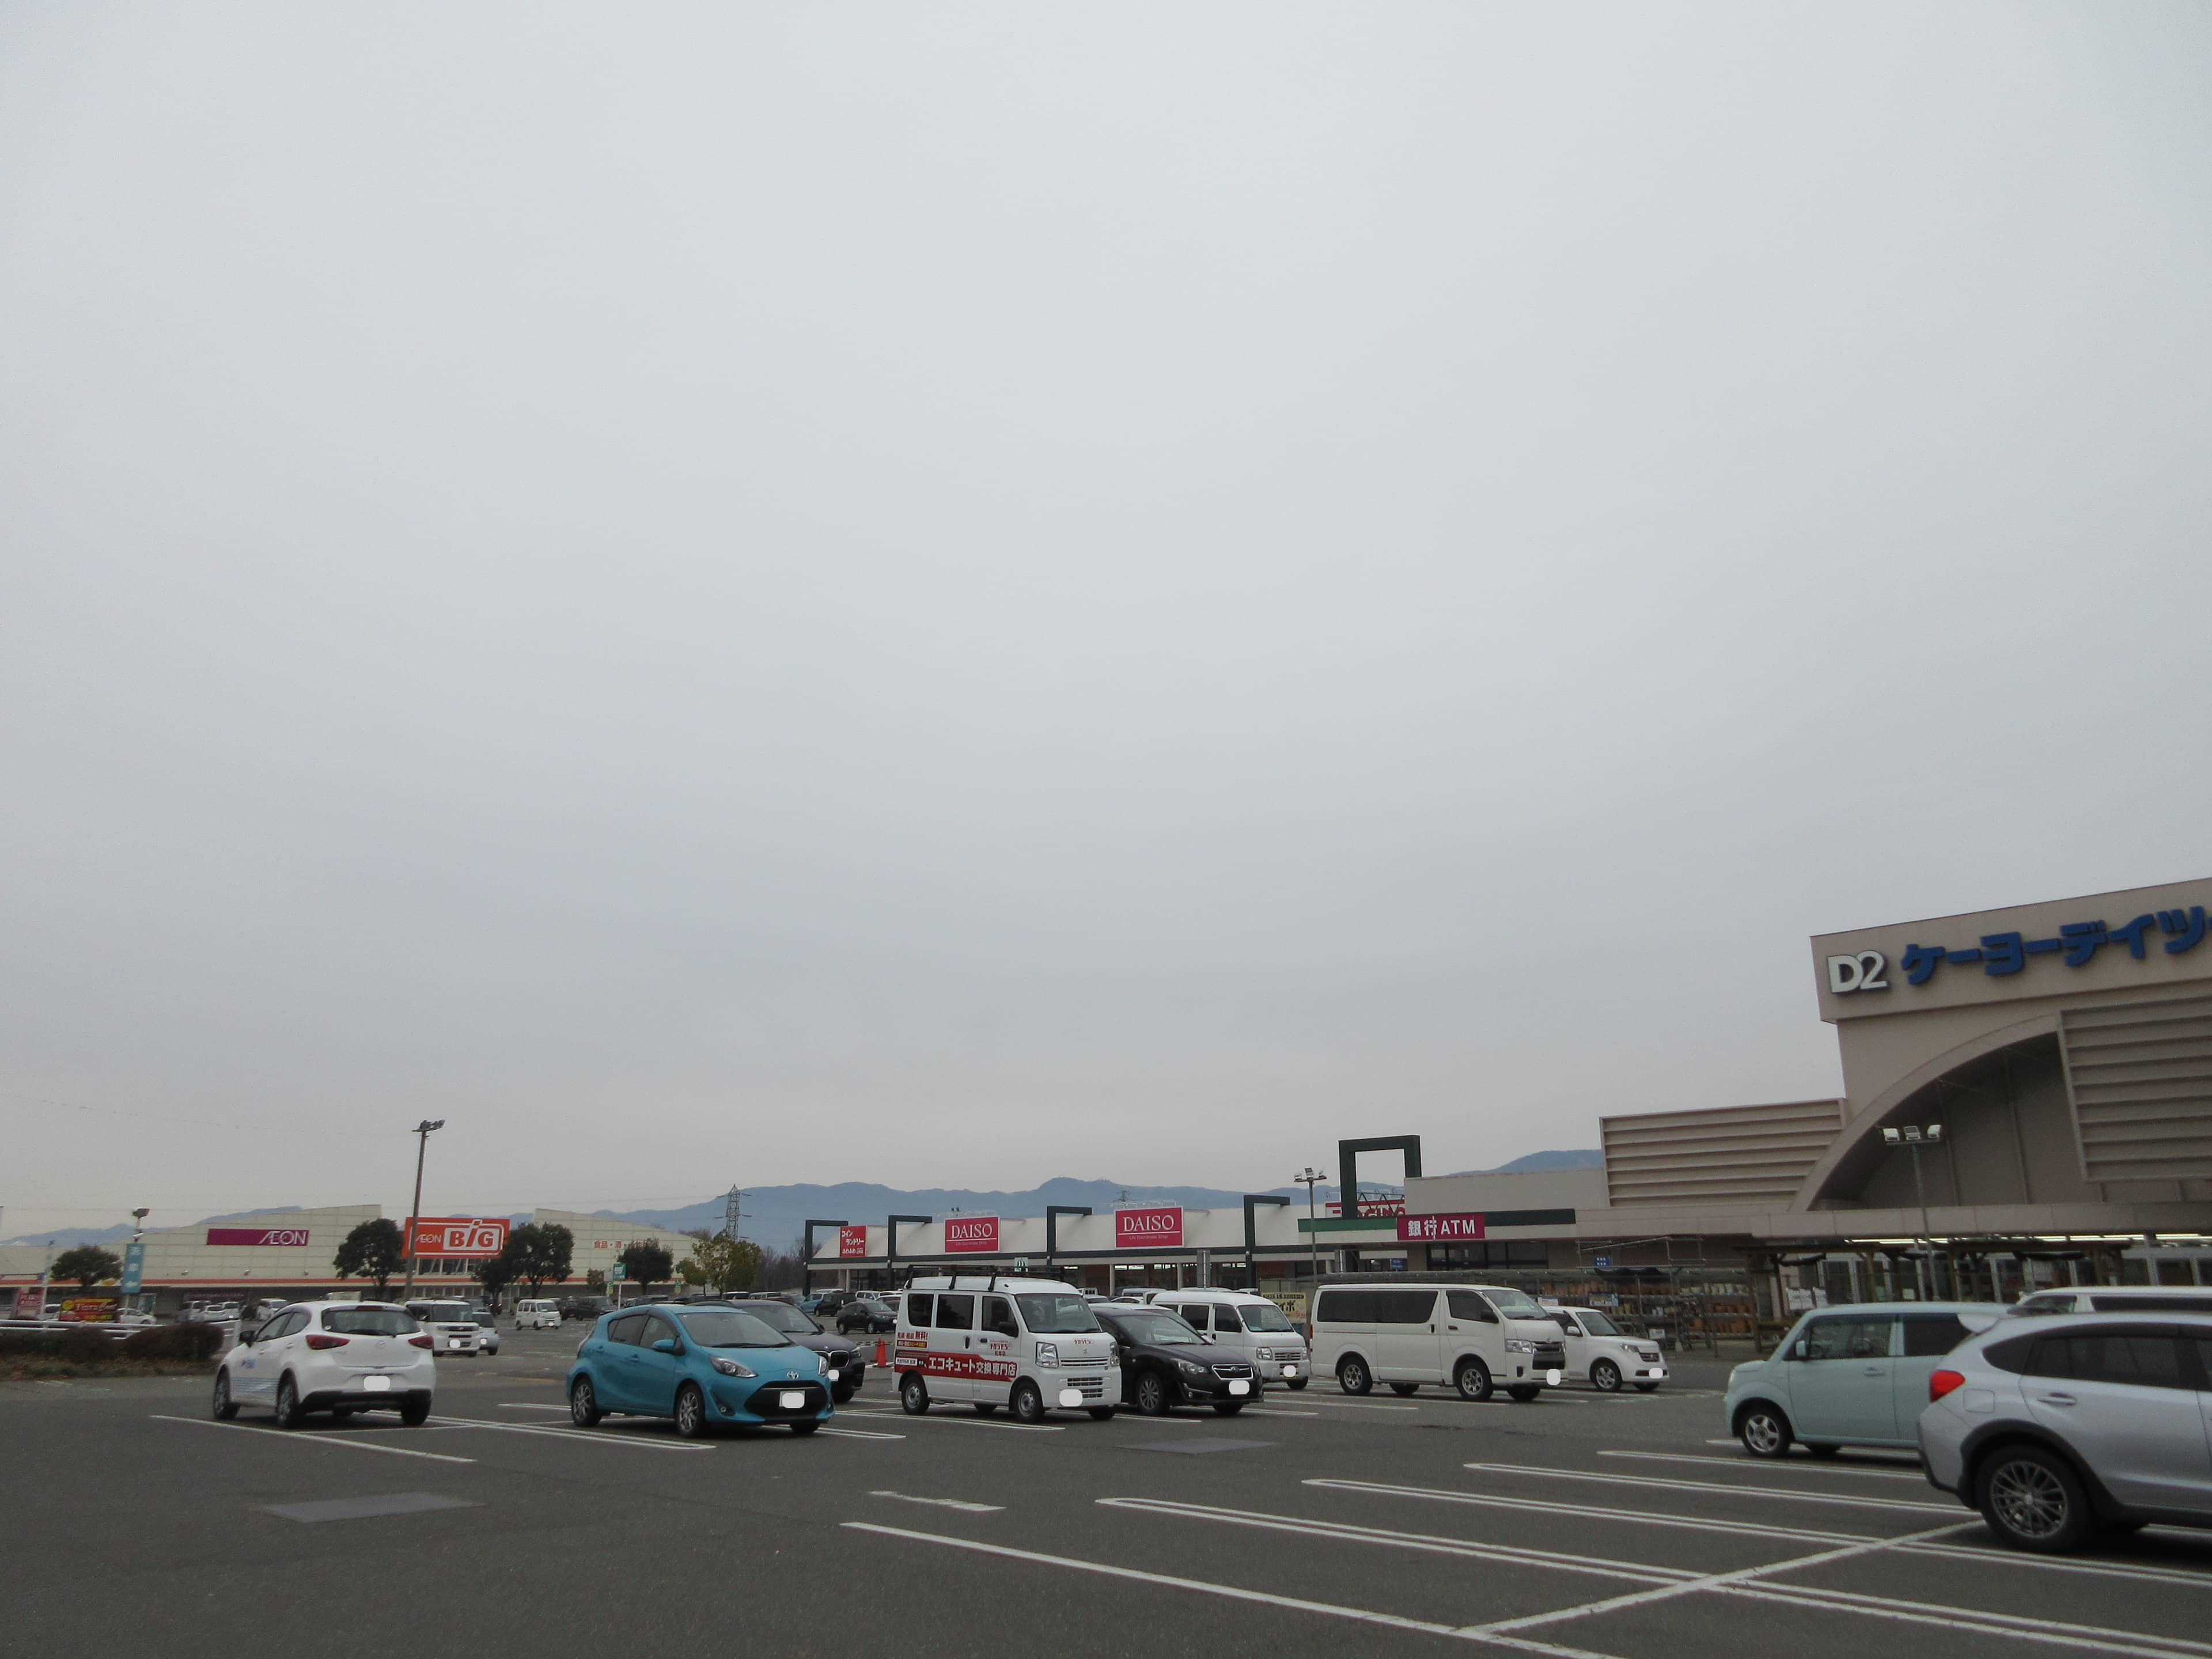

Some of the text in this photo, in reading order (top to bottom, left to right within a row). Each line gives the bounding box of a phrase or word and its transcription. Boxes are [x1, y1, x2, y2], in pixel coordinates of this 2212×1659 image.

[1902, 905, 2212, 986] ケーヨーデイツ
[1827, 950, 1888, 994] D2
[951, 1223, 992, 1238] DAISO
[1123, 1215, 1174, 1232] DAISO
[1408, 1218, 1475, 1237] 銀行ATM
[846, 1238, 865, 1246] ランドリー
[929, 1357, 1016, 1377] エコキュート交換専門店
